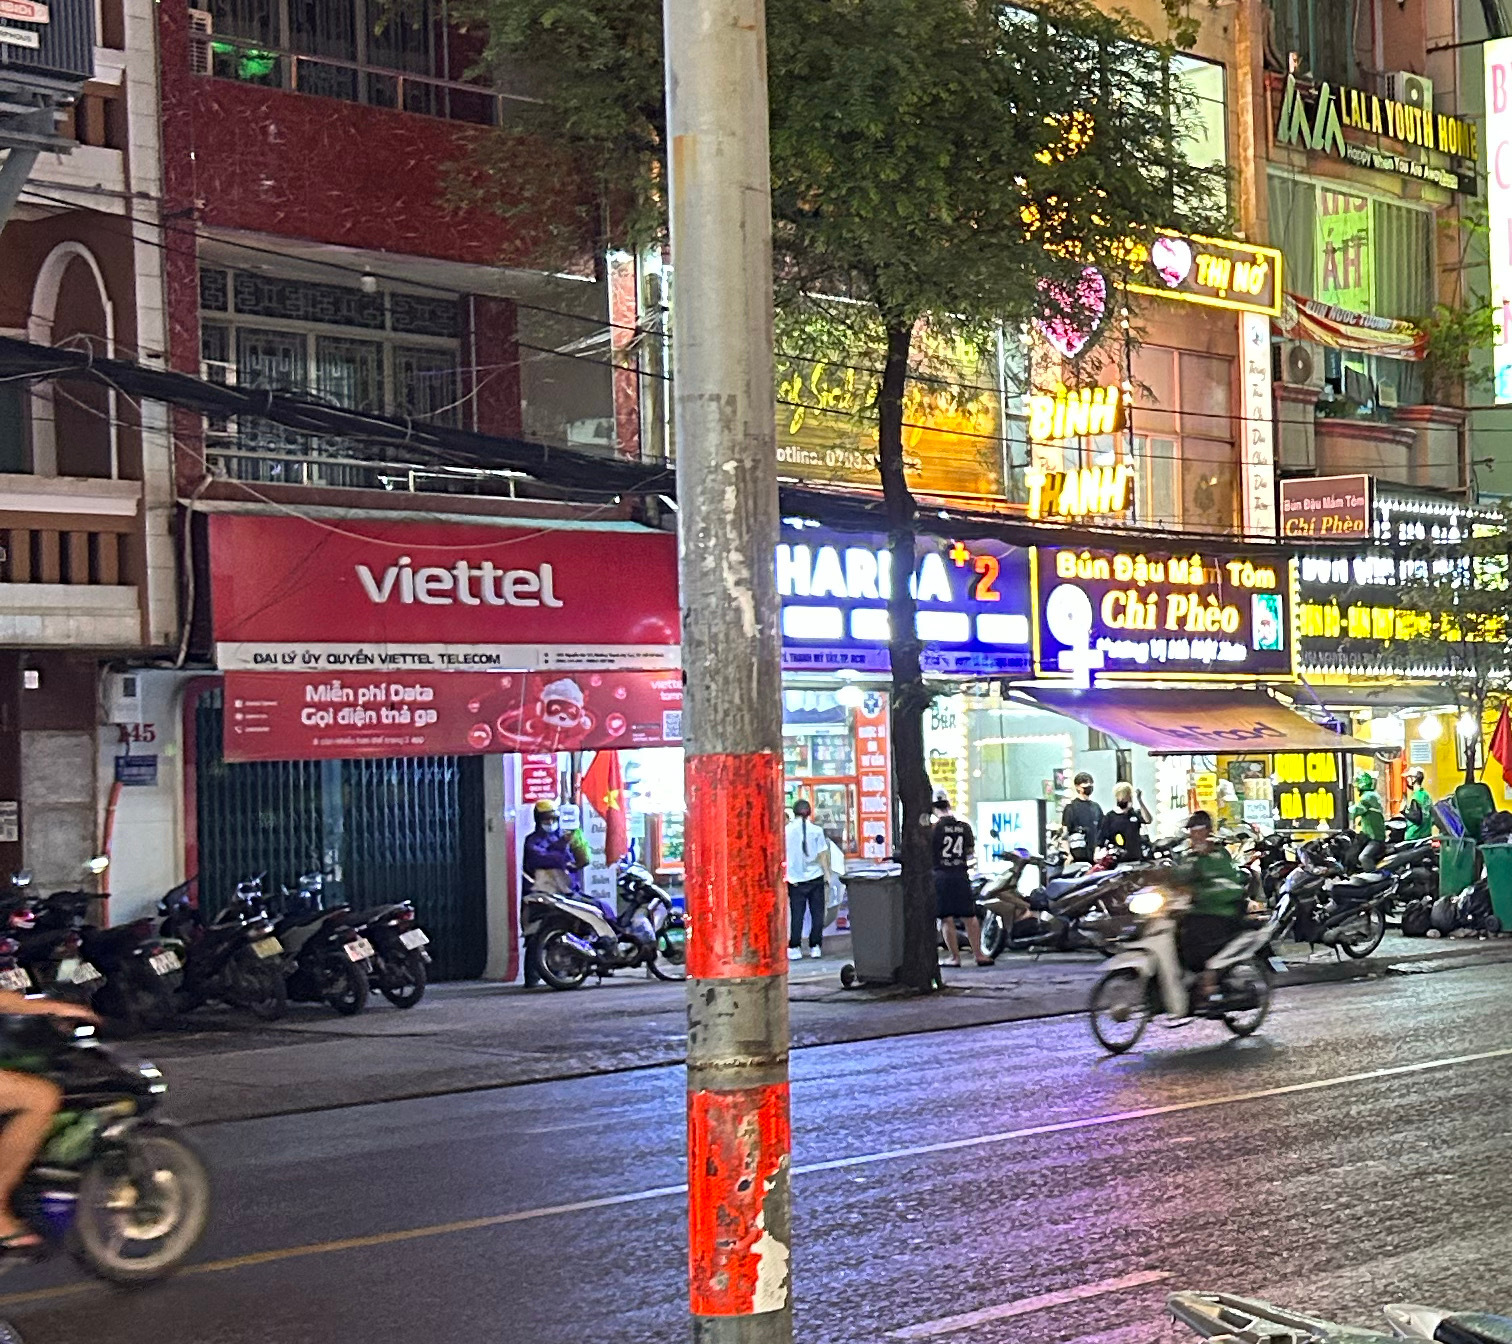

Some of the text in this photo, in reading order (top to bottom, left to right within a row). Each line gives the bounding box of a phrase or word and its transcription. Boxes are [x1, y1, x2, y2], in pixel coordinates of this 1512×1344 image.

[1340, 86, 1478, 161] LALA YOUTH HOME
[1196, 253, 1268, 297] THỊ NỞ
[1285, 517, 1316, 536] Chí
[1320, 515, 1364, 534] Phèo
[355, 556, 563, 608] viettel
[776, 544, 1000, 602] HARA 2
[1056, 550, 1276, 589] Bún Đậu Mắm Tôm
[1101, 589, 1240, 633] Chí Phèo
[379, 653, 434, 665] VIETTEL
[438, 653, 500, 665] TELECOM
[306, 680, 434, 705] Miễn phí Data
[301, 707, 333, 728] Gọi
[337, 706, 376, 727] điện
[414, 709, 438, 727] ga
[943, 836, 964, 857] 24
